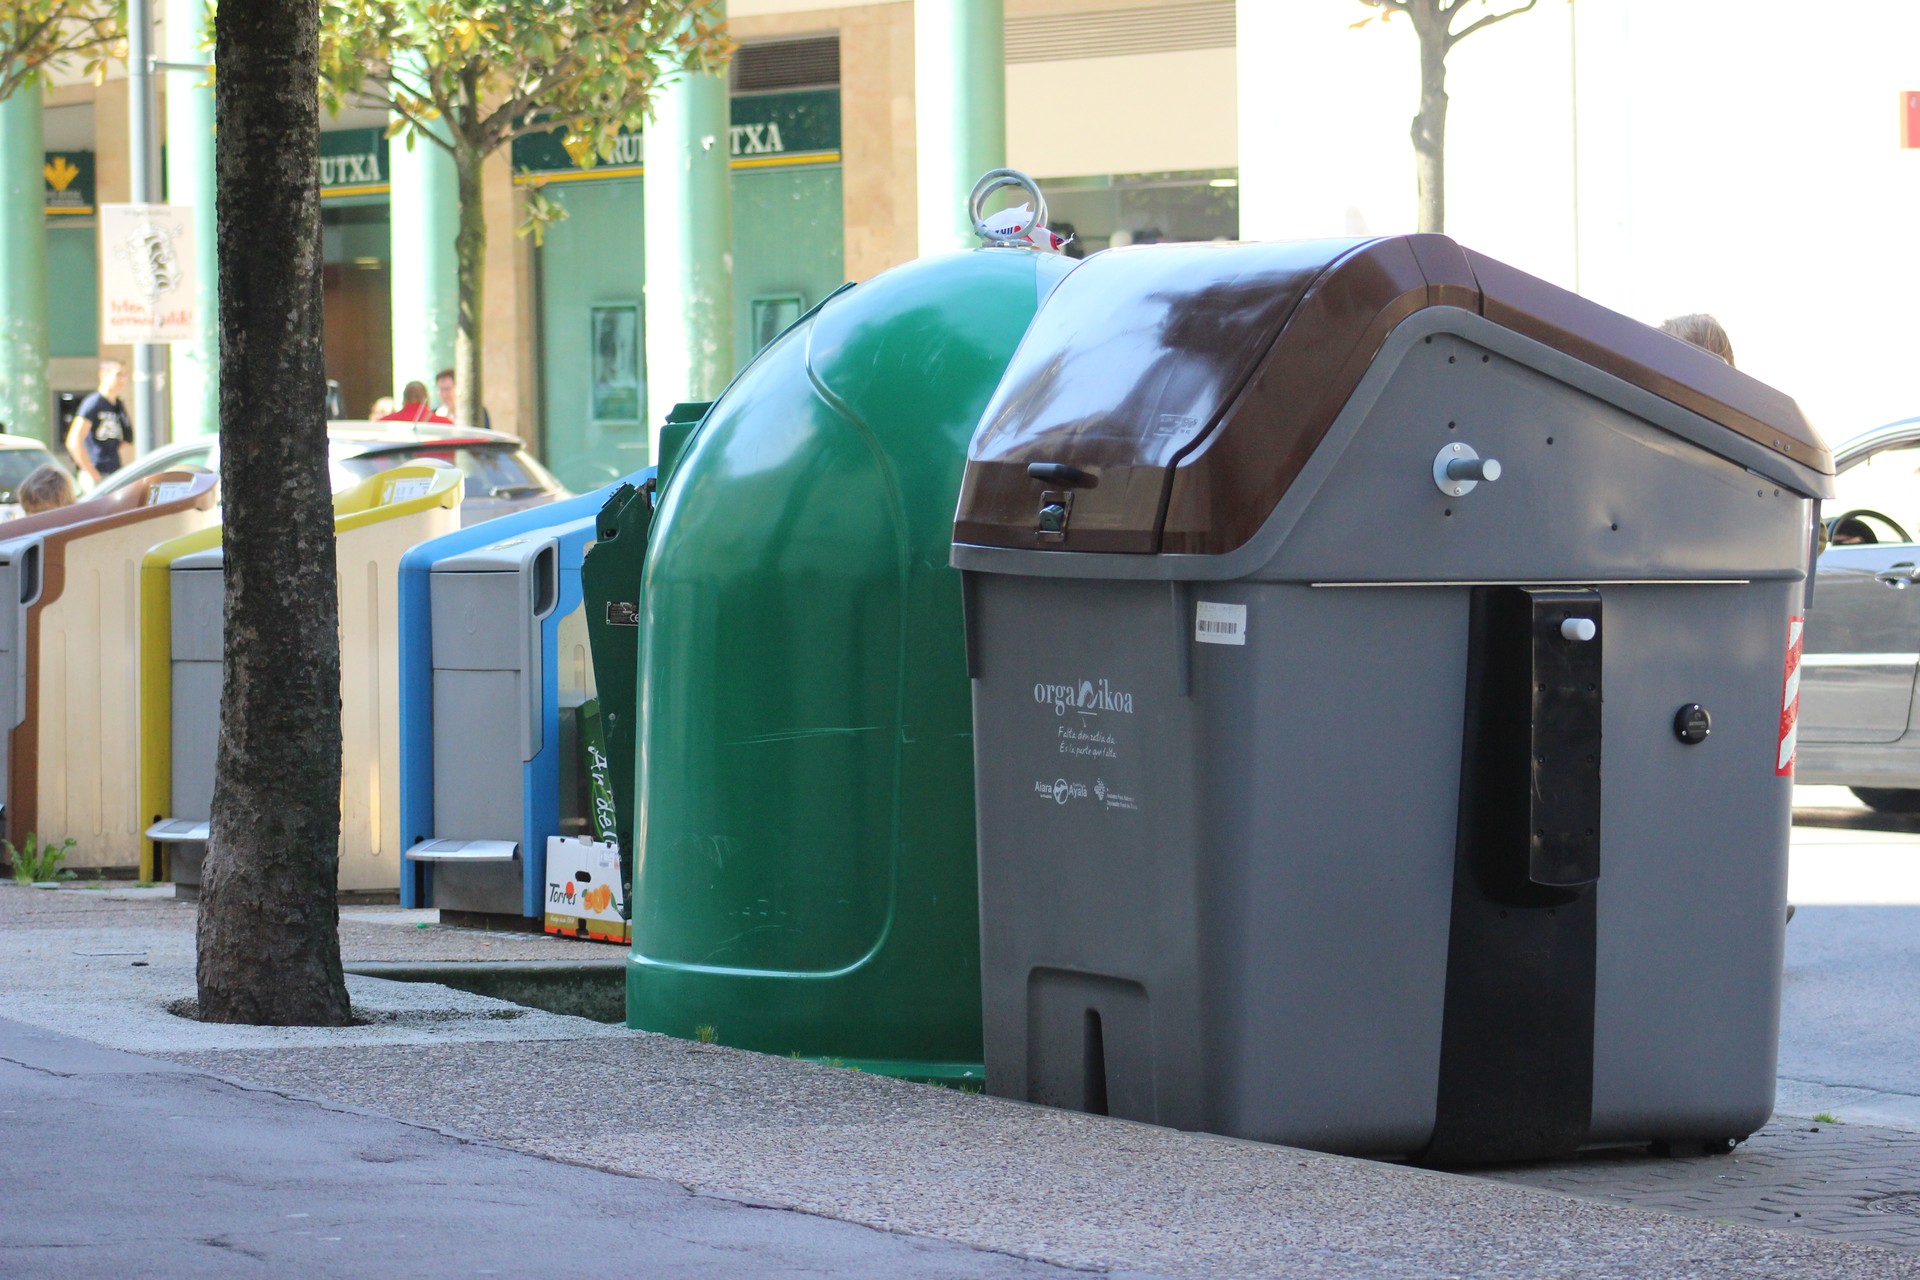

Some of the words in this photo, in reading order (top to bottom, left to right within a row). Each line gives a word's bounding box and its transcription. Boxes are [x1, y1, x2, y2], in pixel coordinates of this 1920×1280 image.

[729, 122, 785, 155] TXA
[320, 154, 381, 185] UTXA
[1058, 726, 1077, 740] Falta
[1106, 733, 1115, 744] da
[1103, 747, 1117, 758] falta
[1034, 780, 1053, 793] Aiara
[1068, 784, 1088, 798] Ayala
[549, 883, 577, 905] Torres
